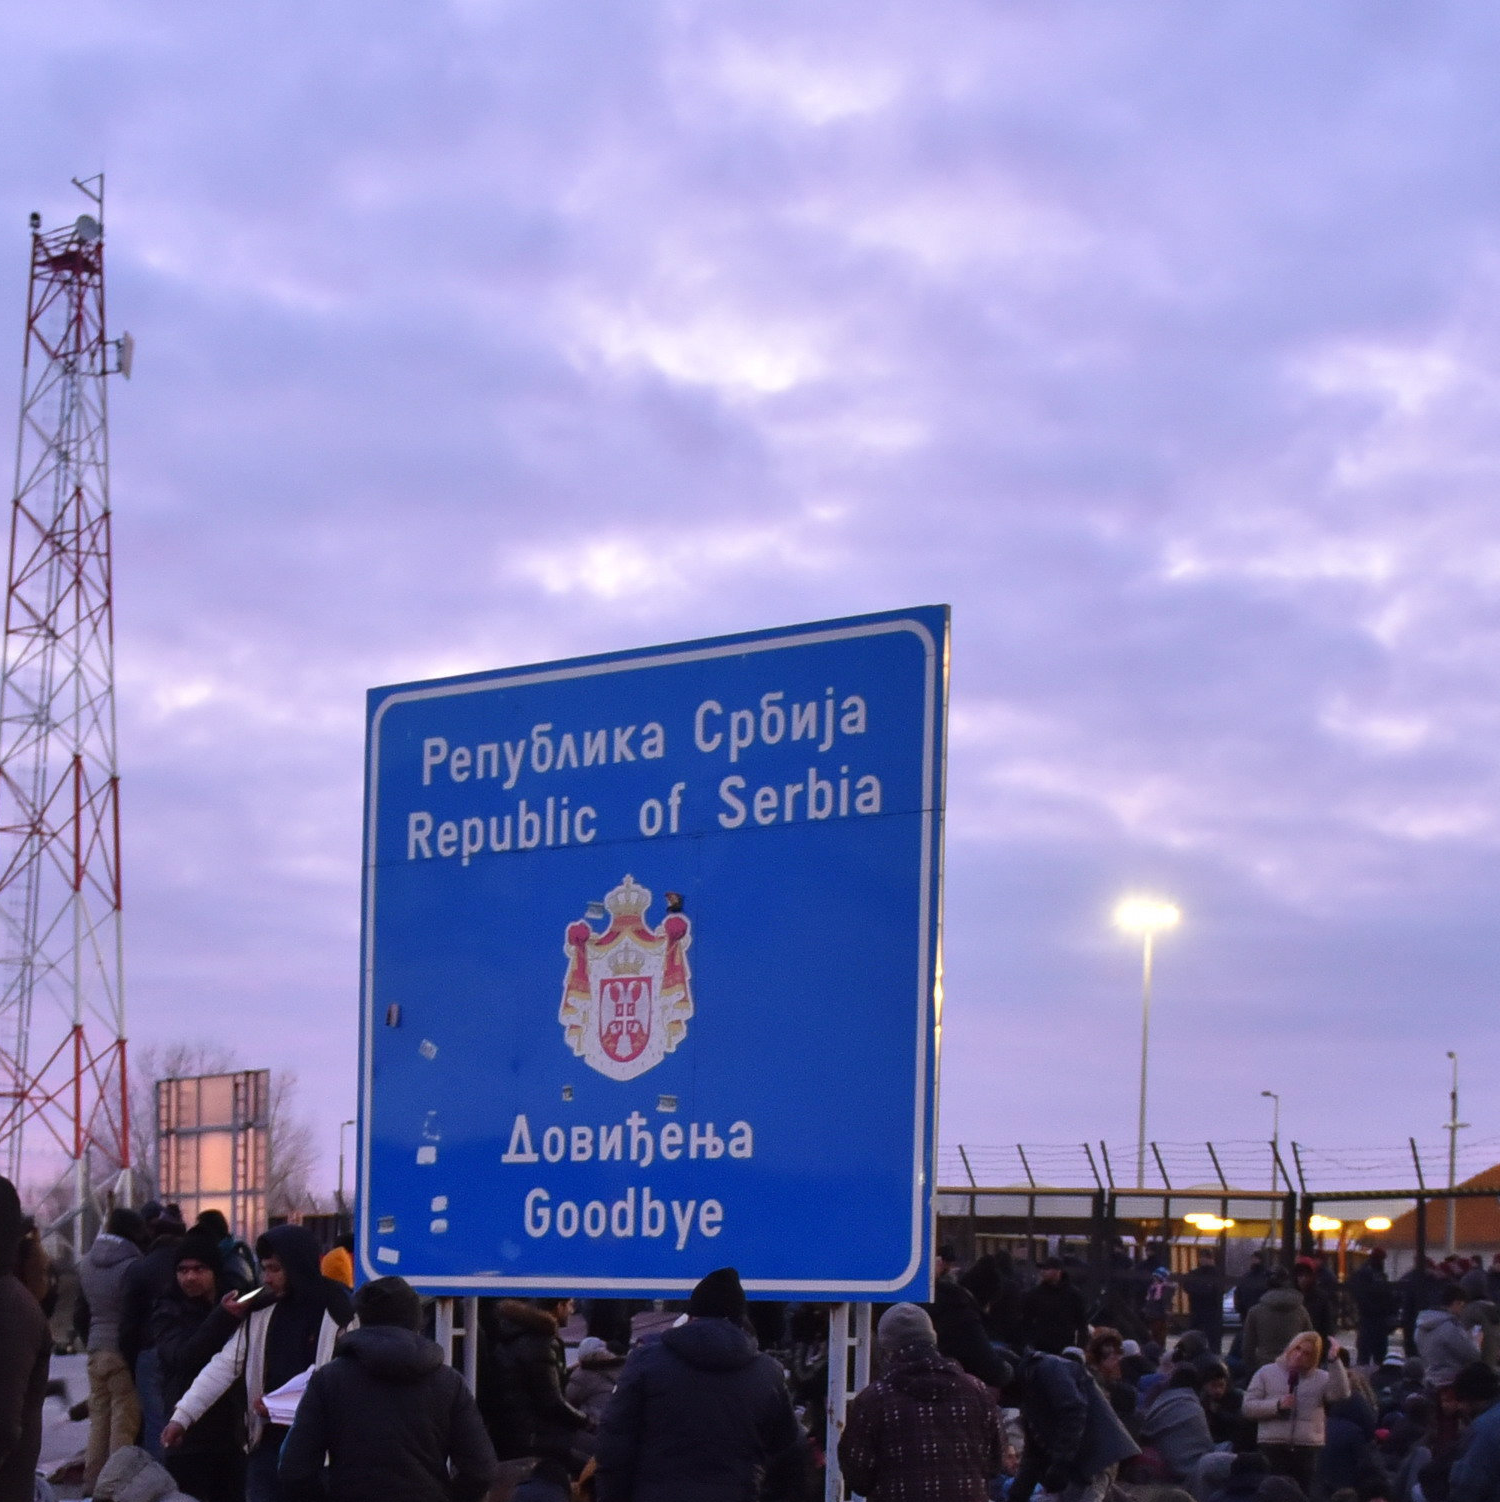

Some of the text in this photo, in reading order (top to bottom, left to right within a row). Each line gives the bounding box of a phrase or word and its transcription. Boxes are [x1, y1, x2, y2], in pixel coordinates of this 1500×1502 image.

[422, 686, 867, 790] Република Србија
[407, 765, 882, 867] Republic of Serbia
[501, 1110, 754, 1168] Довиђења
[524, 1186, 724, 1251] Goodbye
